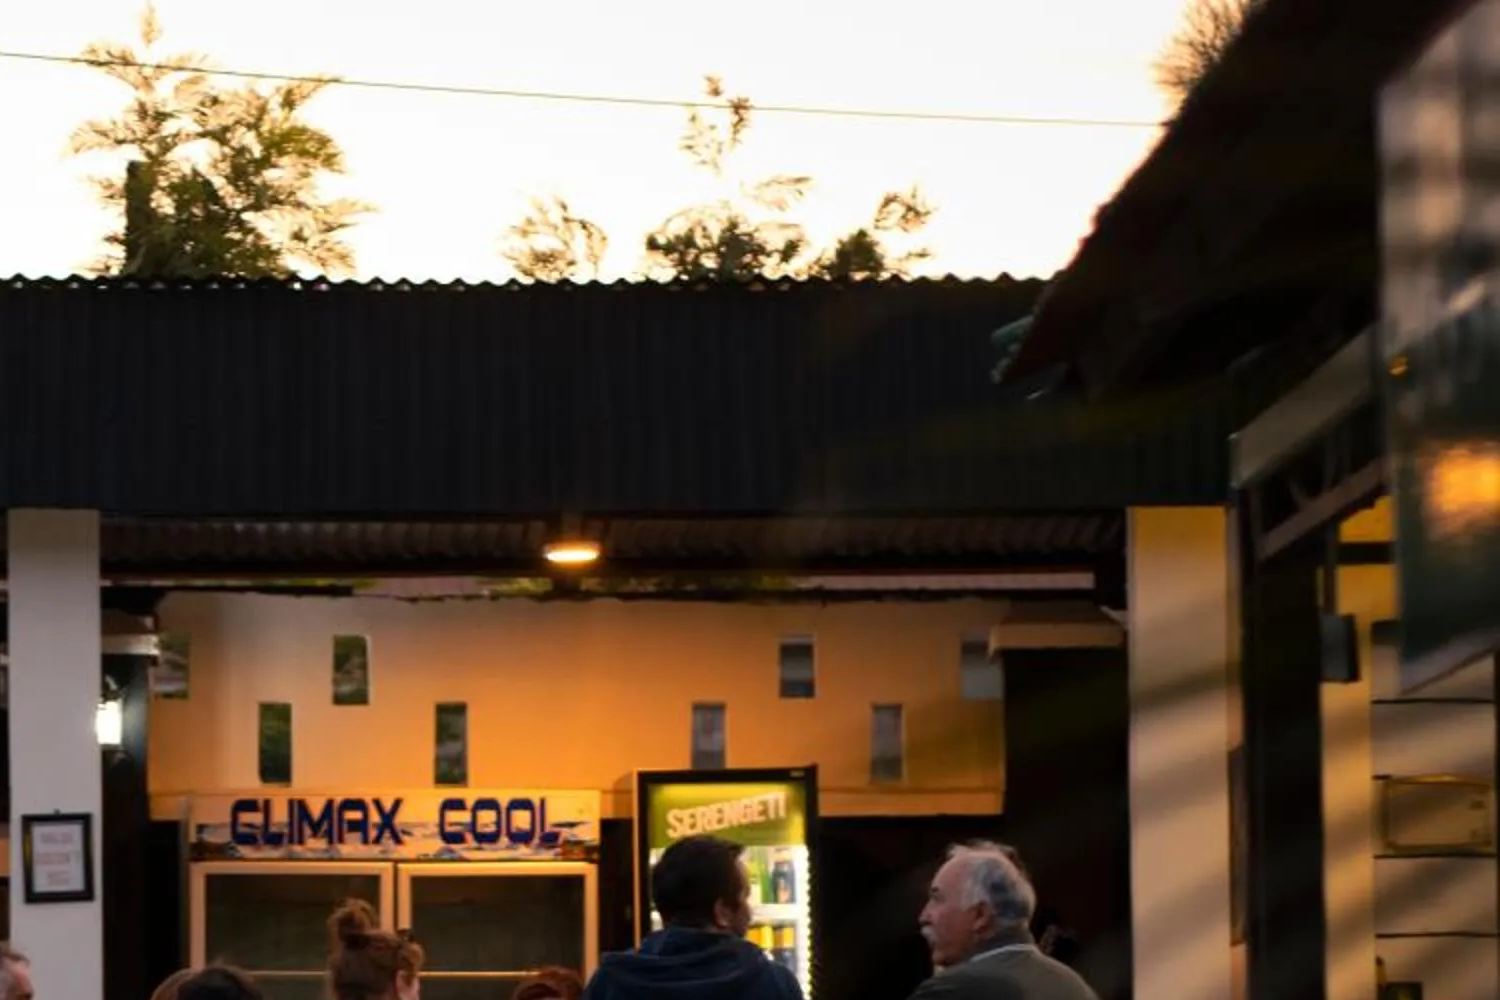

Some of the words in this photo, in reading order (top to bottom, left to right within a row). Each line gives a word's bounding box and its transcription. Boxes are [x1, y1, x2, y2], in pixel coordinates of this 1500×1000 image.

[230, 797, 404, 846] CLIMAX
[438, 797, 562, 846] COOL
[666, 791, 787, 839] SERENGETI
